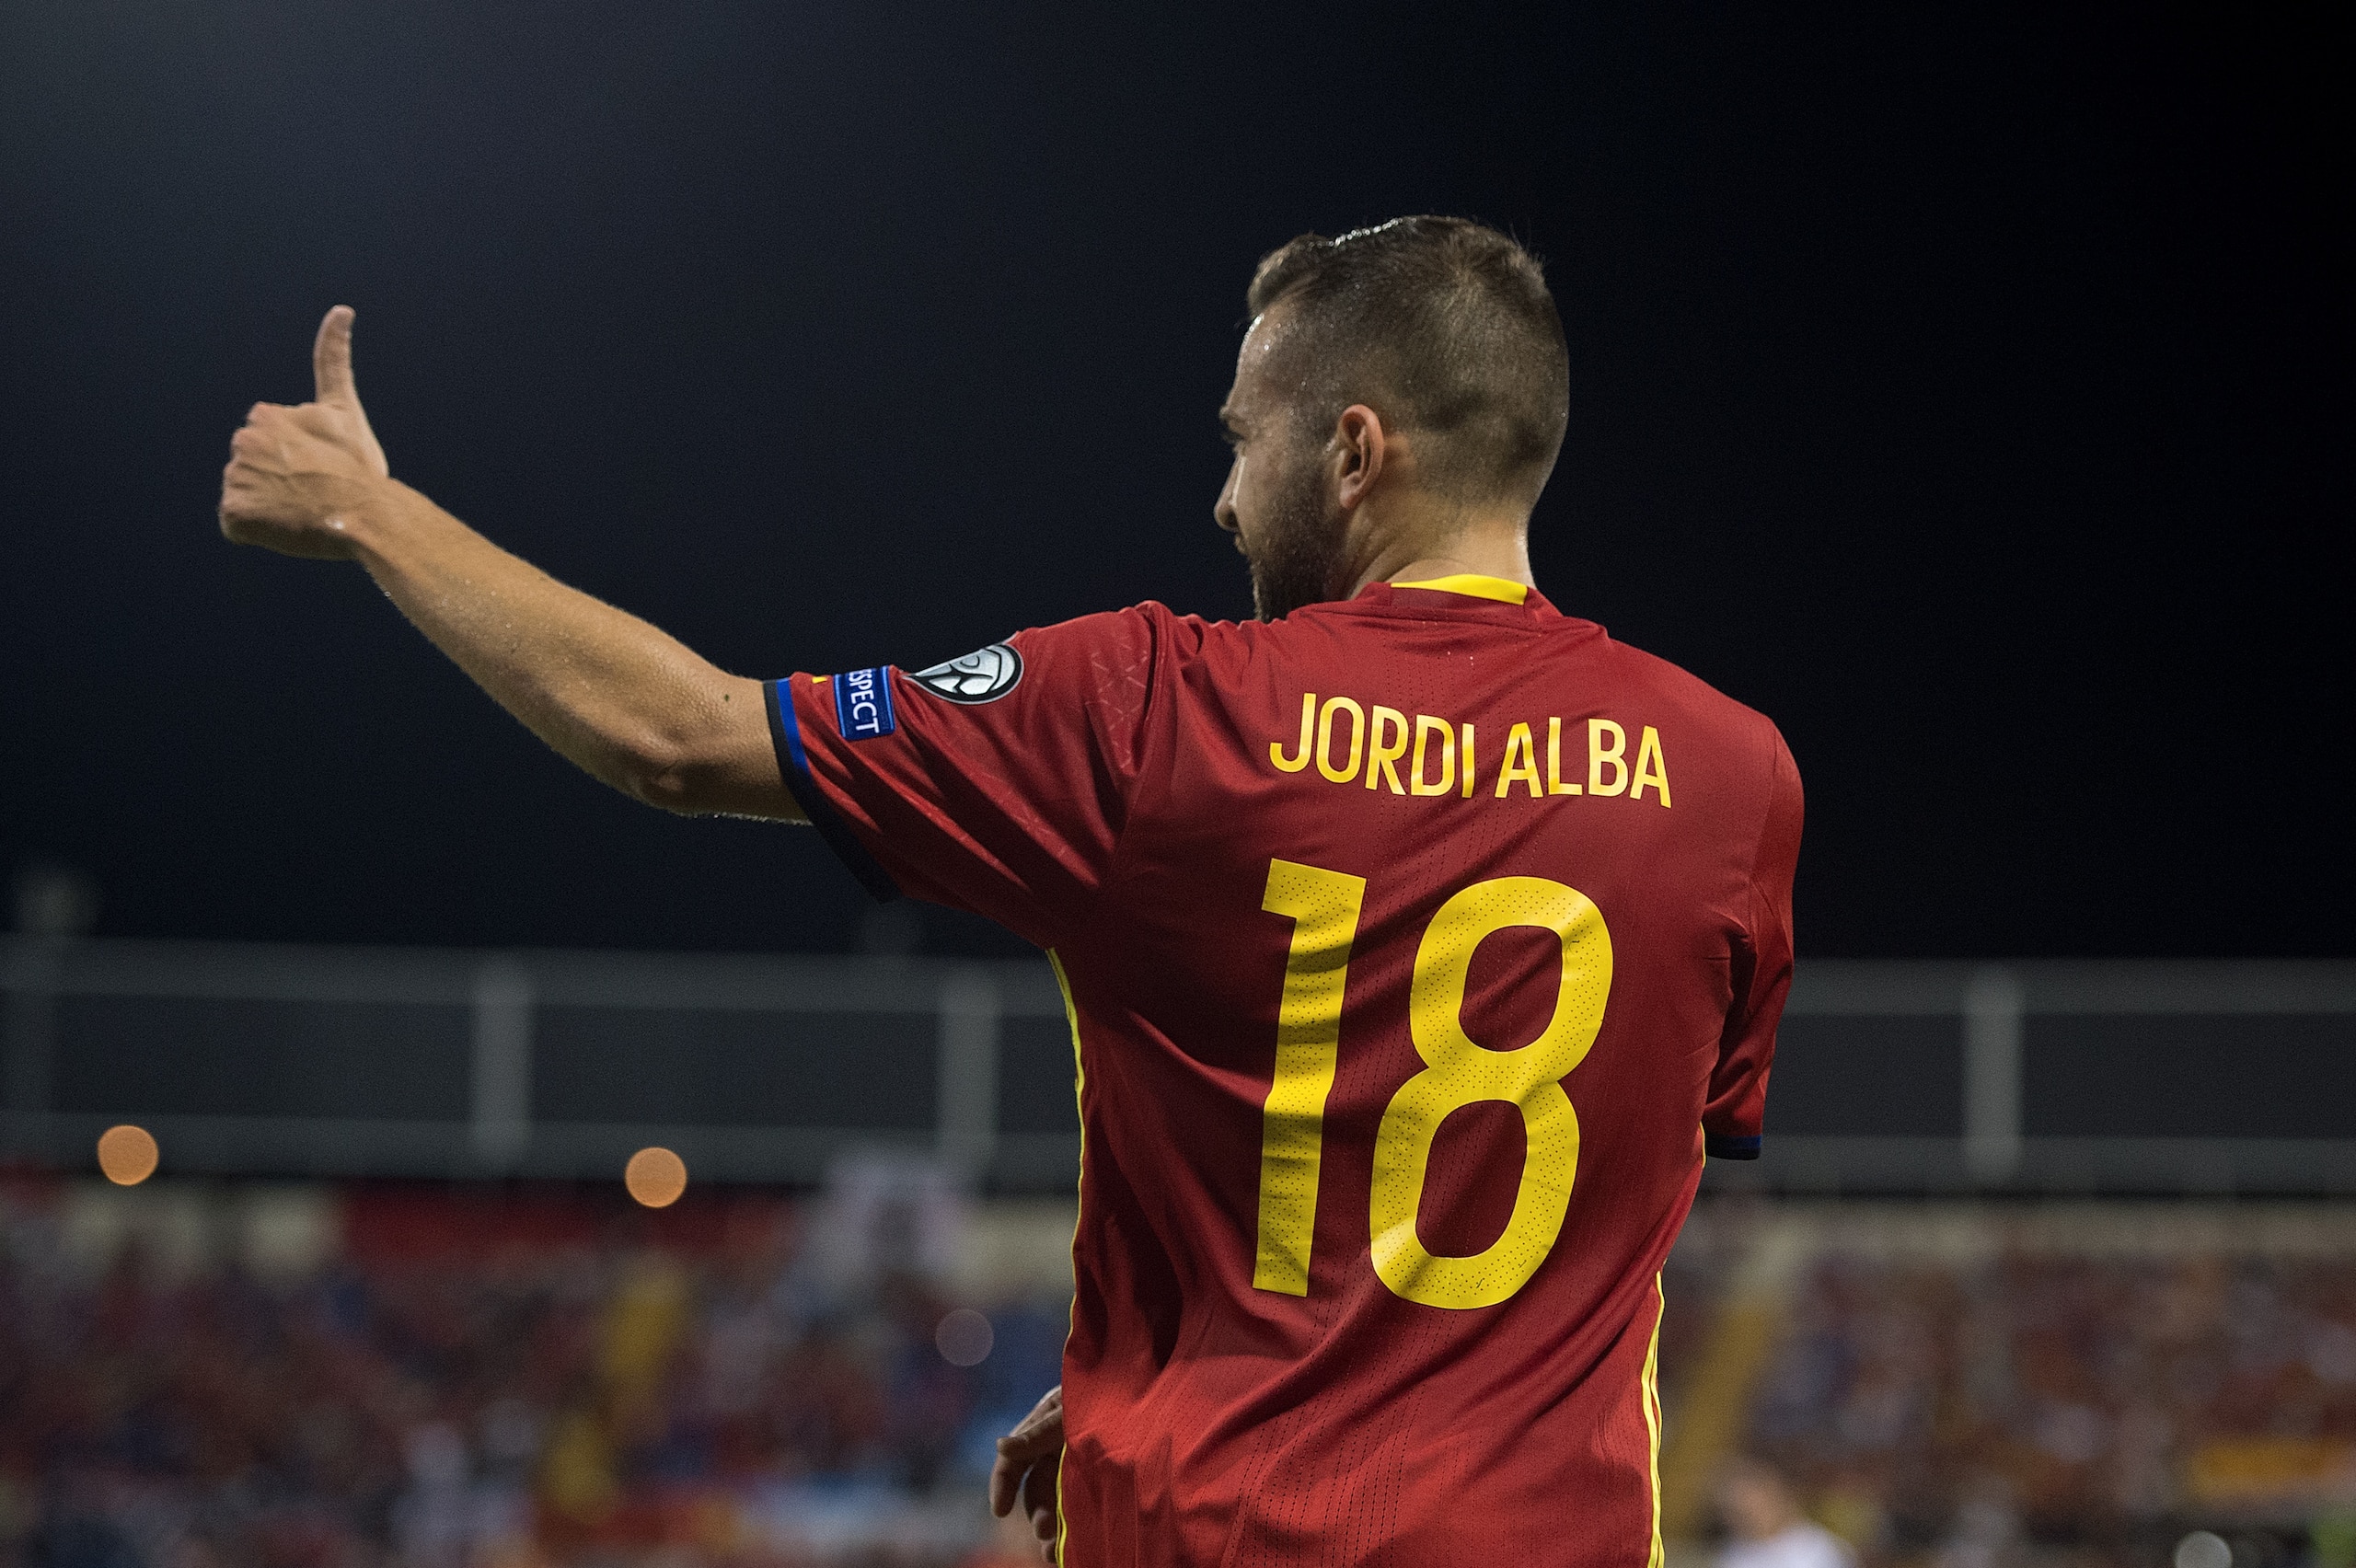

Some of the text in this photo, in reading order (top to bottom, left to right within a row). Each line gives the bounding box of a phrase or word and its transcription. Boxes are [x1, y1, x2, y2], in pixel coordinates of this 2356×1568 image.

[1270, 693, 1672, 809] JORDI ALBA
[1253, 858, 1614, 1310] 18
